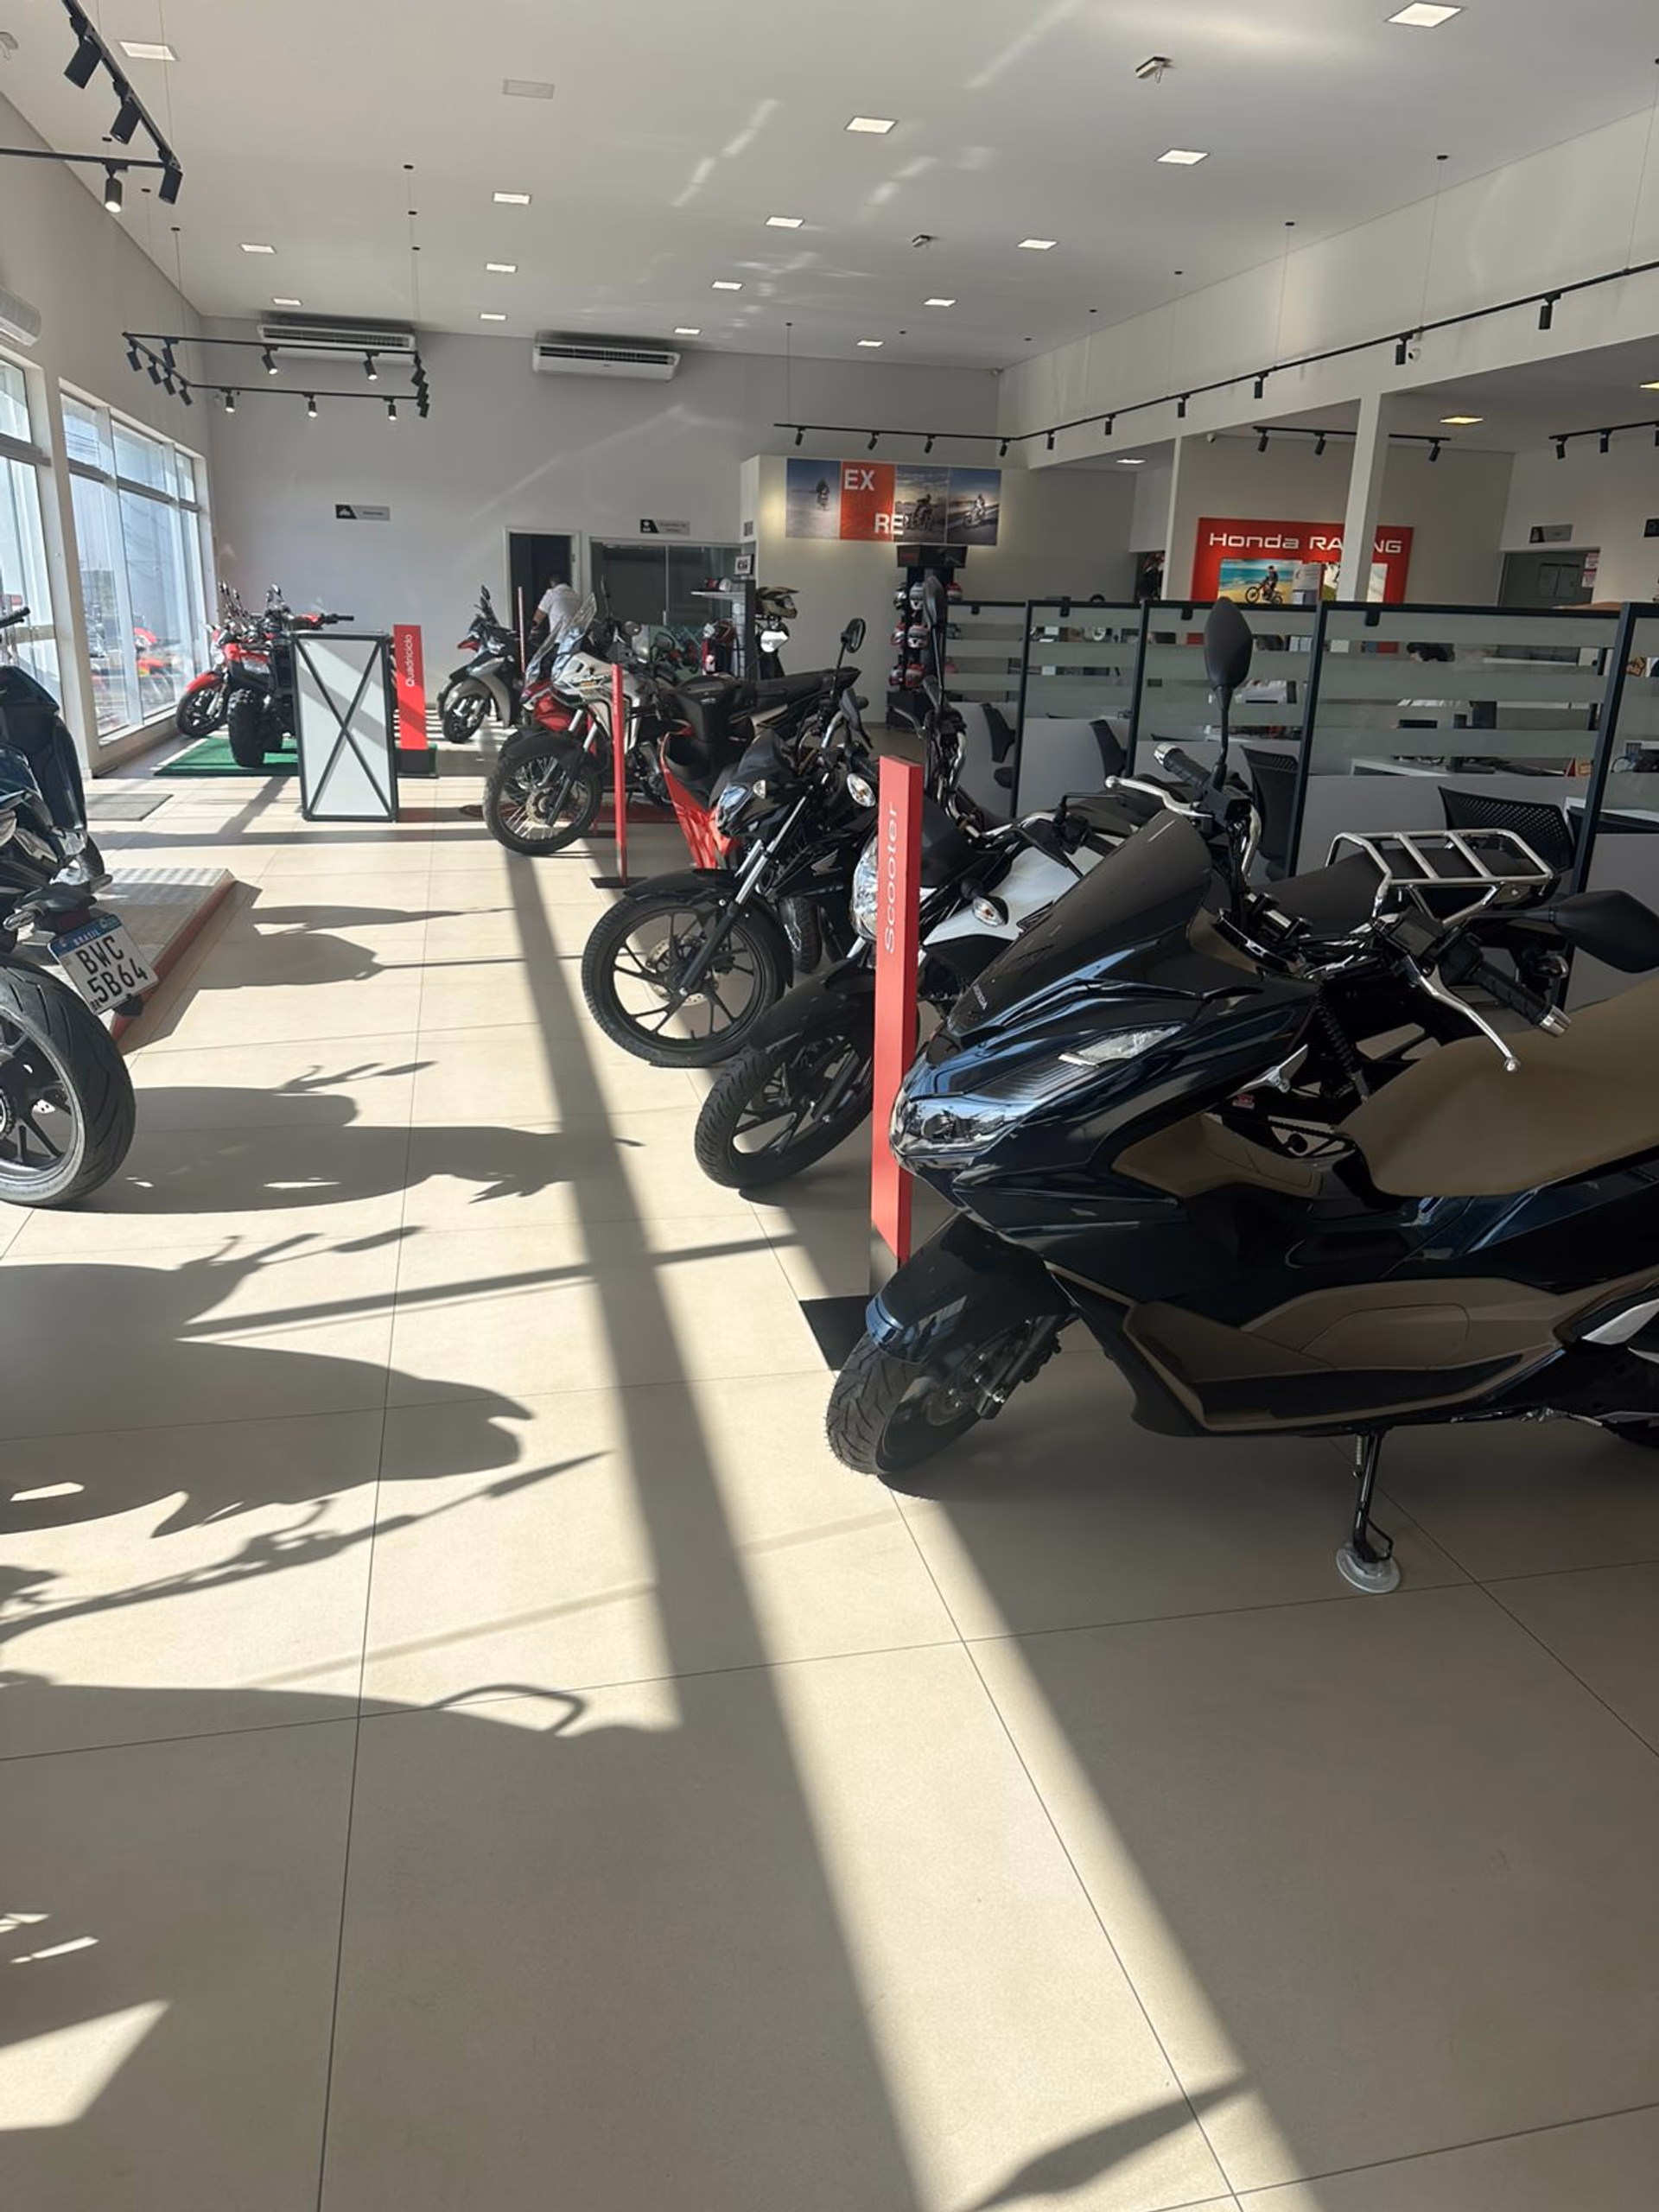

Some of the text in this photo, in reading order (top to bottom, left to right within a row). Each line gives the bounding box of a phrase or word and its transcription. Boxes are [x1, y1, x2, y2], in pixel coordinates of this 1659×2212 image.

[844, 469, 874, 491] EX
[874, 513, 904, 535] RE
[1210, 533, 1402, 554] Honda RANG
[404, 634, 415, 687] Quadriciclo
[885, 802, 897, 953] Scooter
[73, 929, 100, 946] BRASIL
[76, 936, 124, 975] BWC
[87, 958, 148, 1002] 5B64
